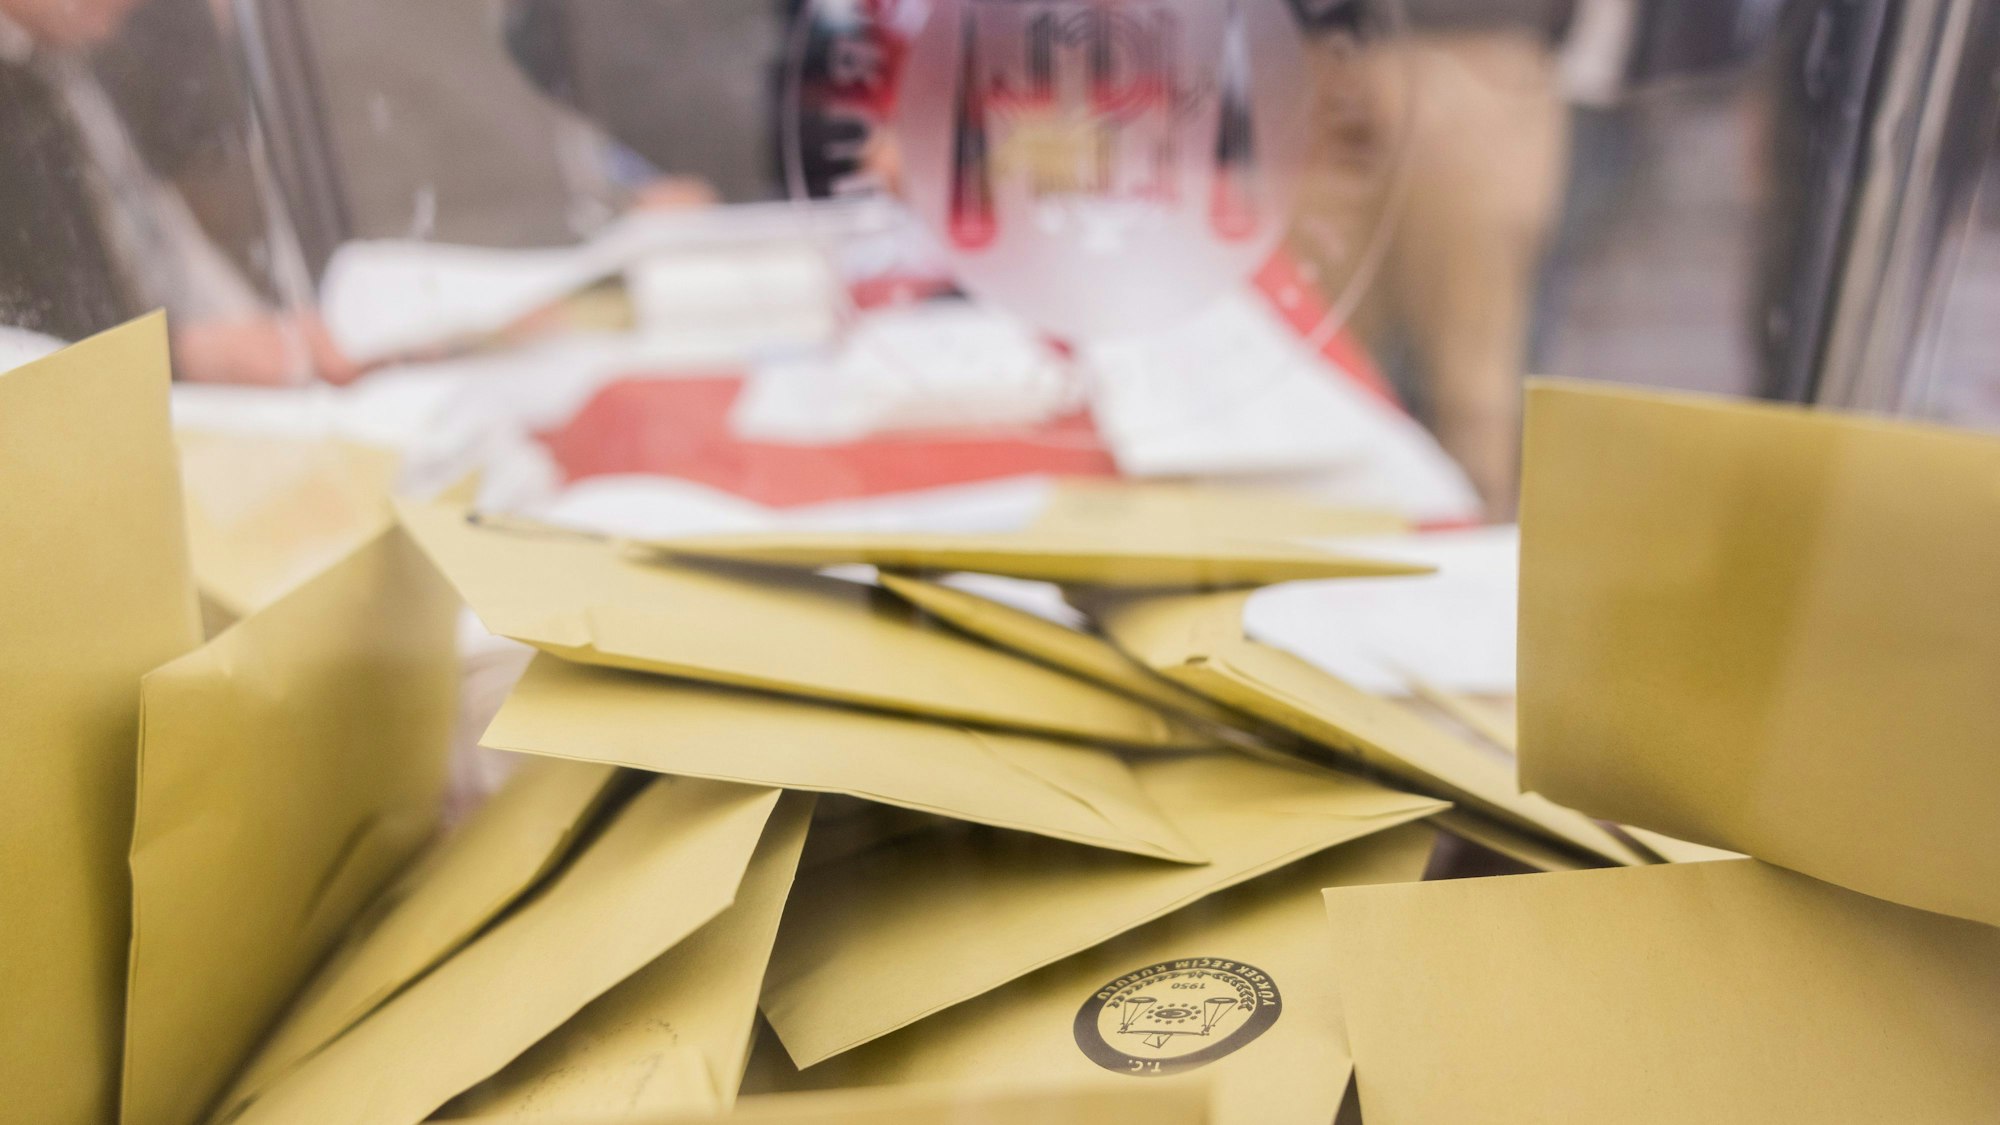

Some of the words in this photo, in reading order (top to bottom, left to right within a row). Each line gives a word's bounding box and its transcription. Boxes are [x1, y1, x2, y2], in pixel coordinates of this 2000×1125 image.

[1096, 964, 1166, 1001] KURULU
[1171, 982, 1206, 990] 1950
[1236, 963, 1275, 1006] YÜKSEK
[1128, 1059, 1162, 1073] T.C.
